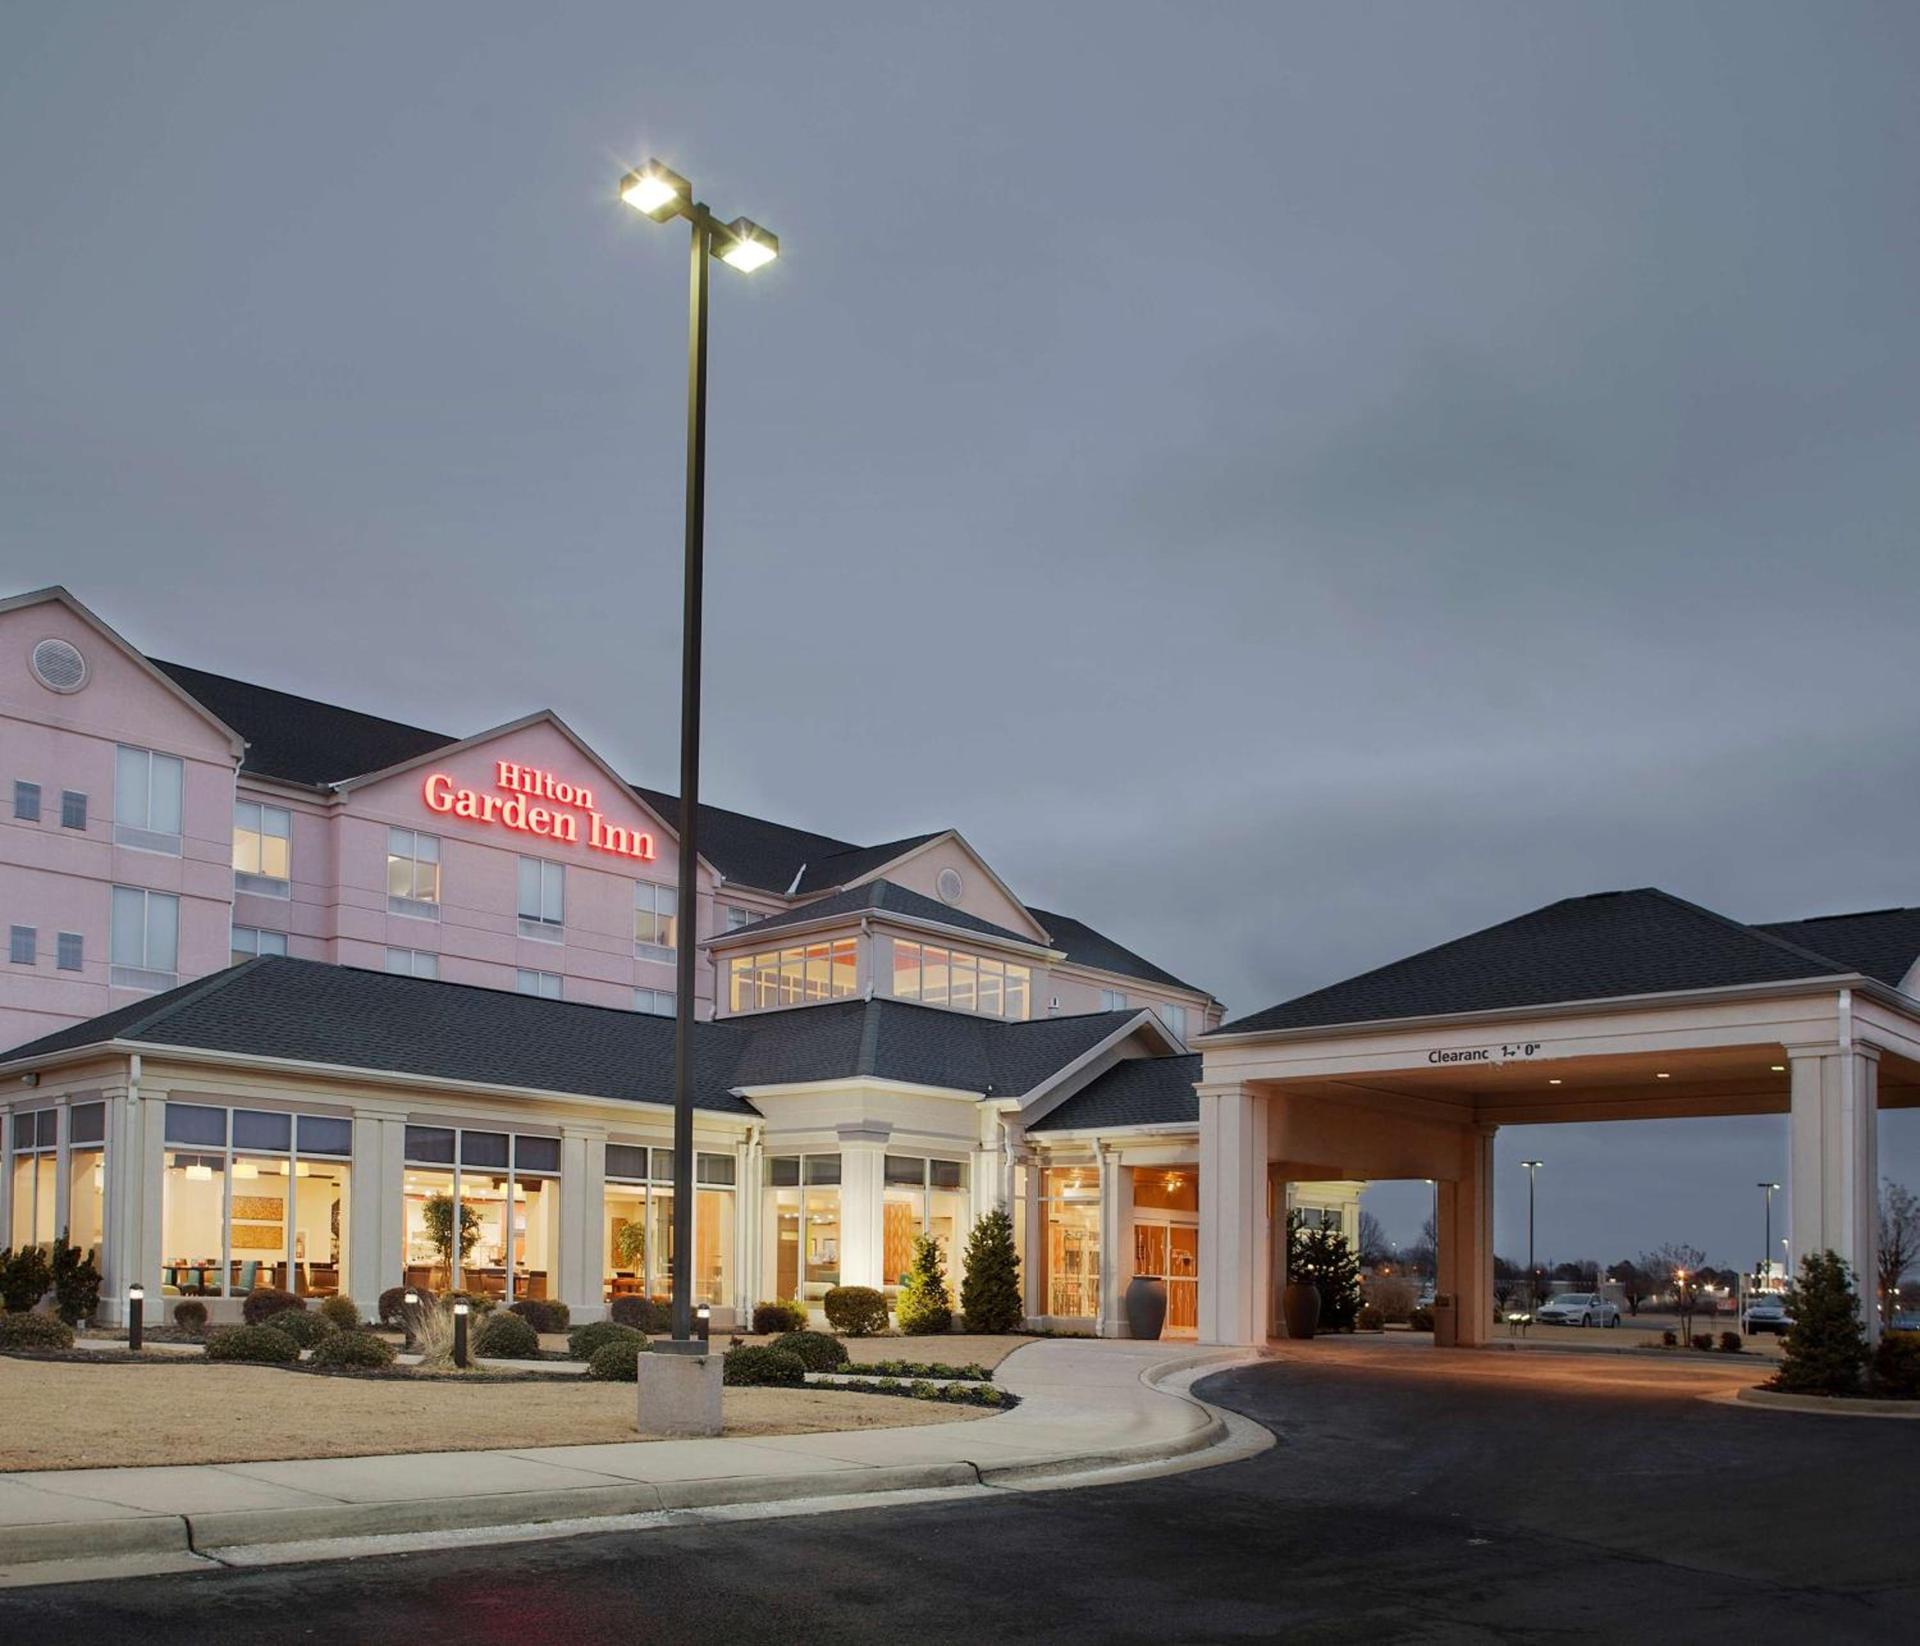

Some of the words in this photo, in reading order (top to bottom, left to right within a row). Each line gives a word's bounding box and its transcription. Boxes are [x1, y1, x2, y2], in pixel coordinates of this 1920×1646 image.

[424, 773, 578, 842] Garden
[588, 811, 656, 859] Inn
[497, 761, 594, 809] Hilton
